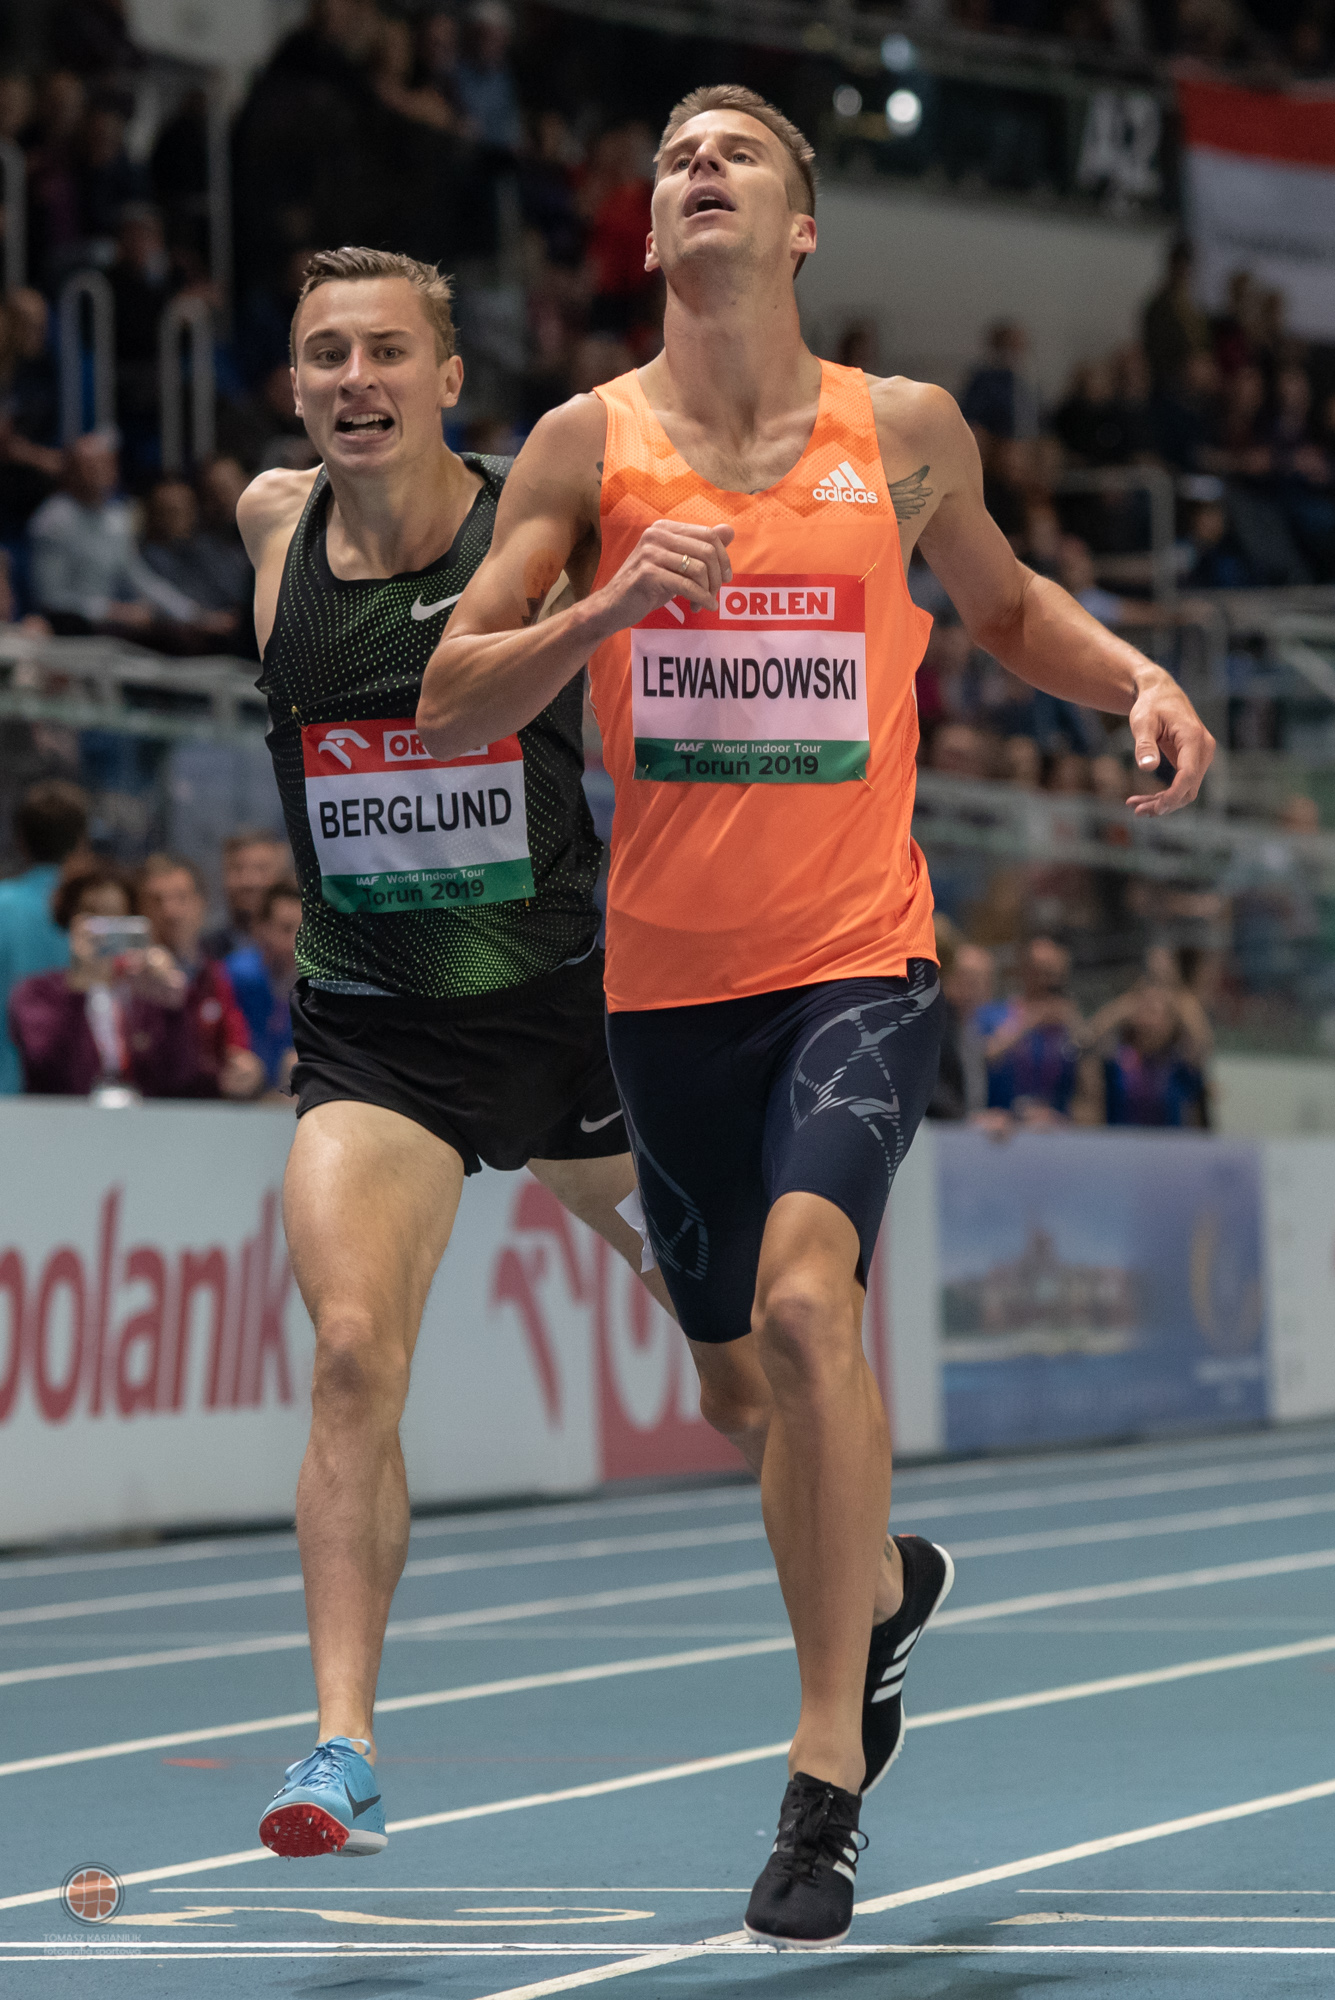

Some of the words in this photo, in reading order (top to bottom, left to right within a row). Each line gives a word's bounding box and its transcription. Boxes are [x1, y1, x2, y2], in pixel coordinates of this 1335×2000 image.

[812, 486, 879, 504] adidas
[725, 591, 828, 616] ORLEN
[642, 656, 857, 701] LEWANDOWSKI
[673, 742, 705, 752] IAAF
[712, 743, 748, 753] World
[751, 743, 791, 753] Indoor
[794, 742, 822, 753] Tour
[680, 754, 750, 775] Toruń
[758, 755, 819, 775] 2019
[319, 787, 512, 839] BERGLUND
[356, 875, 379, 886] IAAF
[386, 873, 419, 884] World
[422, 871, 457, 881] Indoor
[460, 869, 486, 879] Tour
[362, 883, 423, 906] Toruń
[430, 879, 485, 900] 2019
